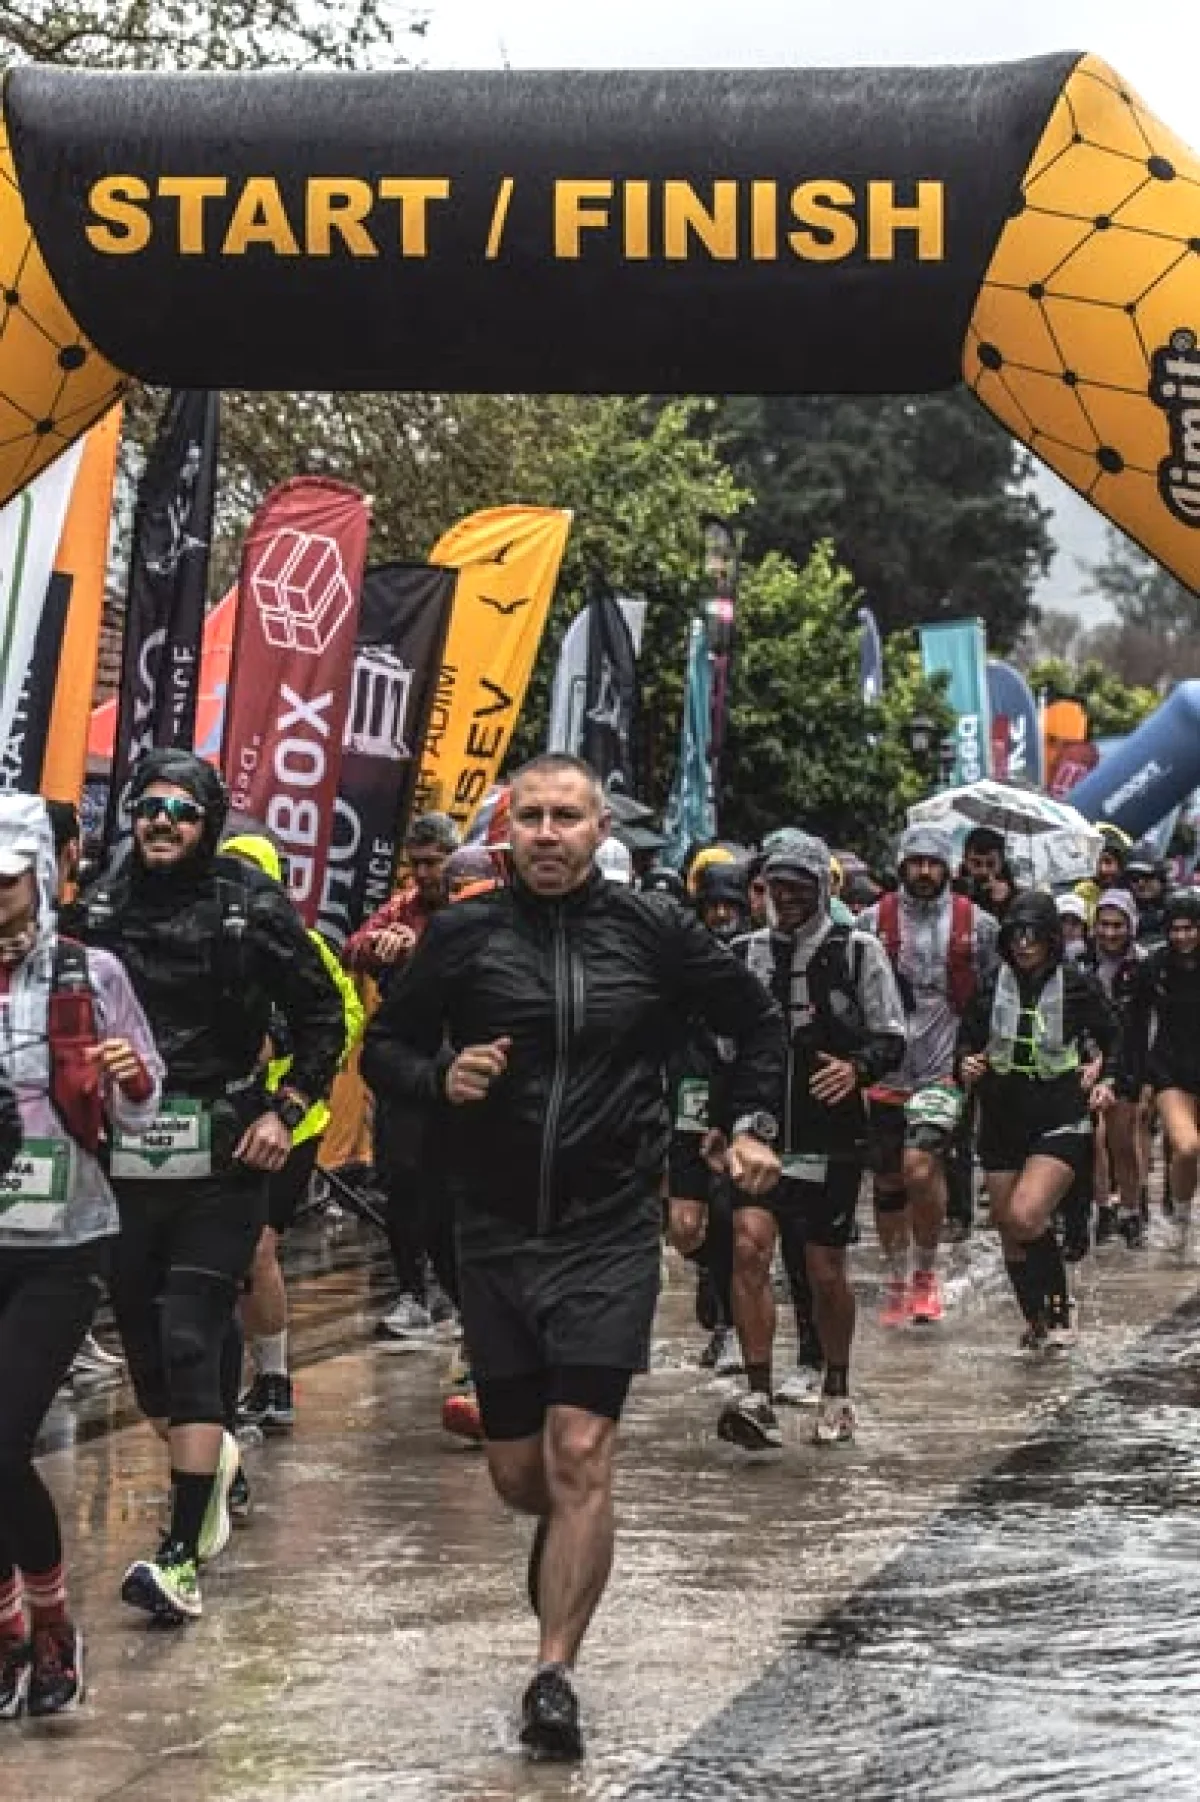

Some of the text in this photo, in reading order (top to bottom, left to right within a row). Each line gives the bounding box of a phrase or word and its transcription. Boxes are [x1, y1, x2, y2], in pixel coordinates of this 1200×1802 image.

[86, 176, 944, 261] START / FINISH
